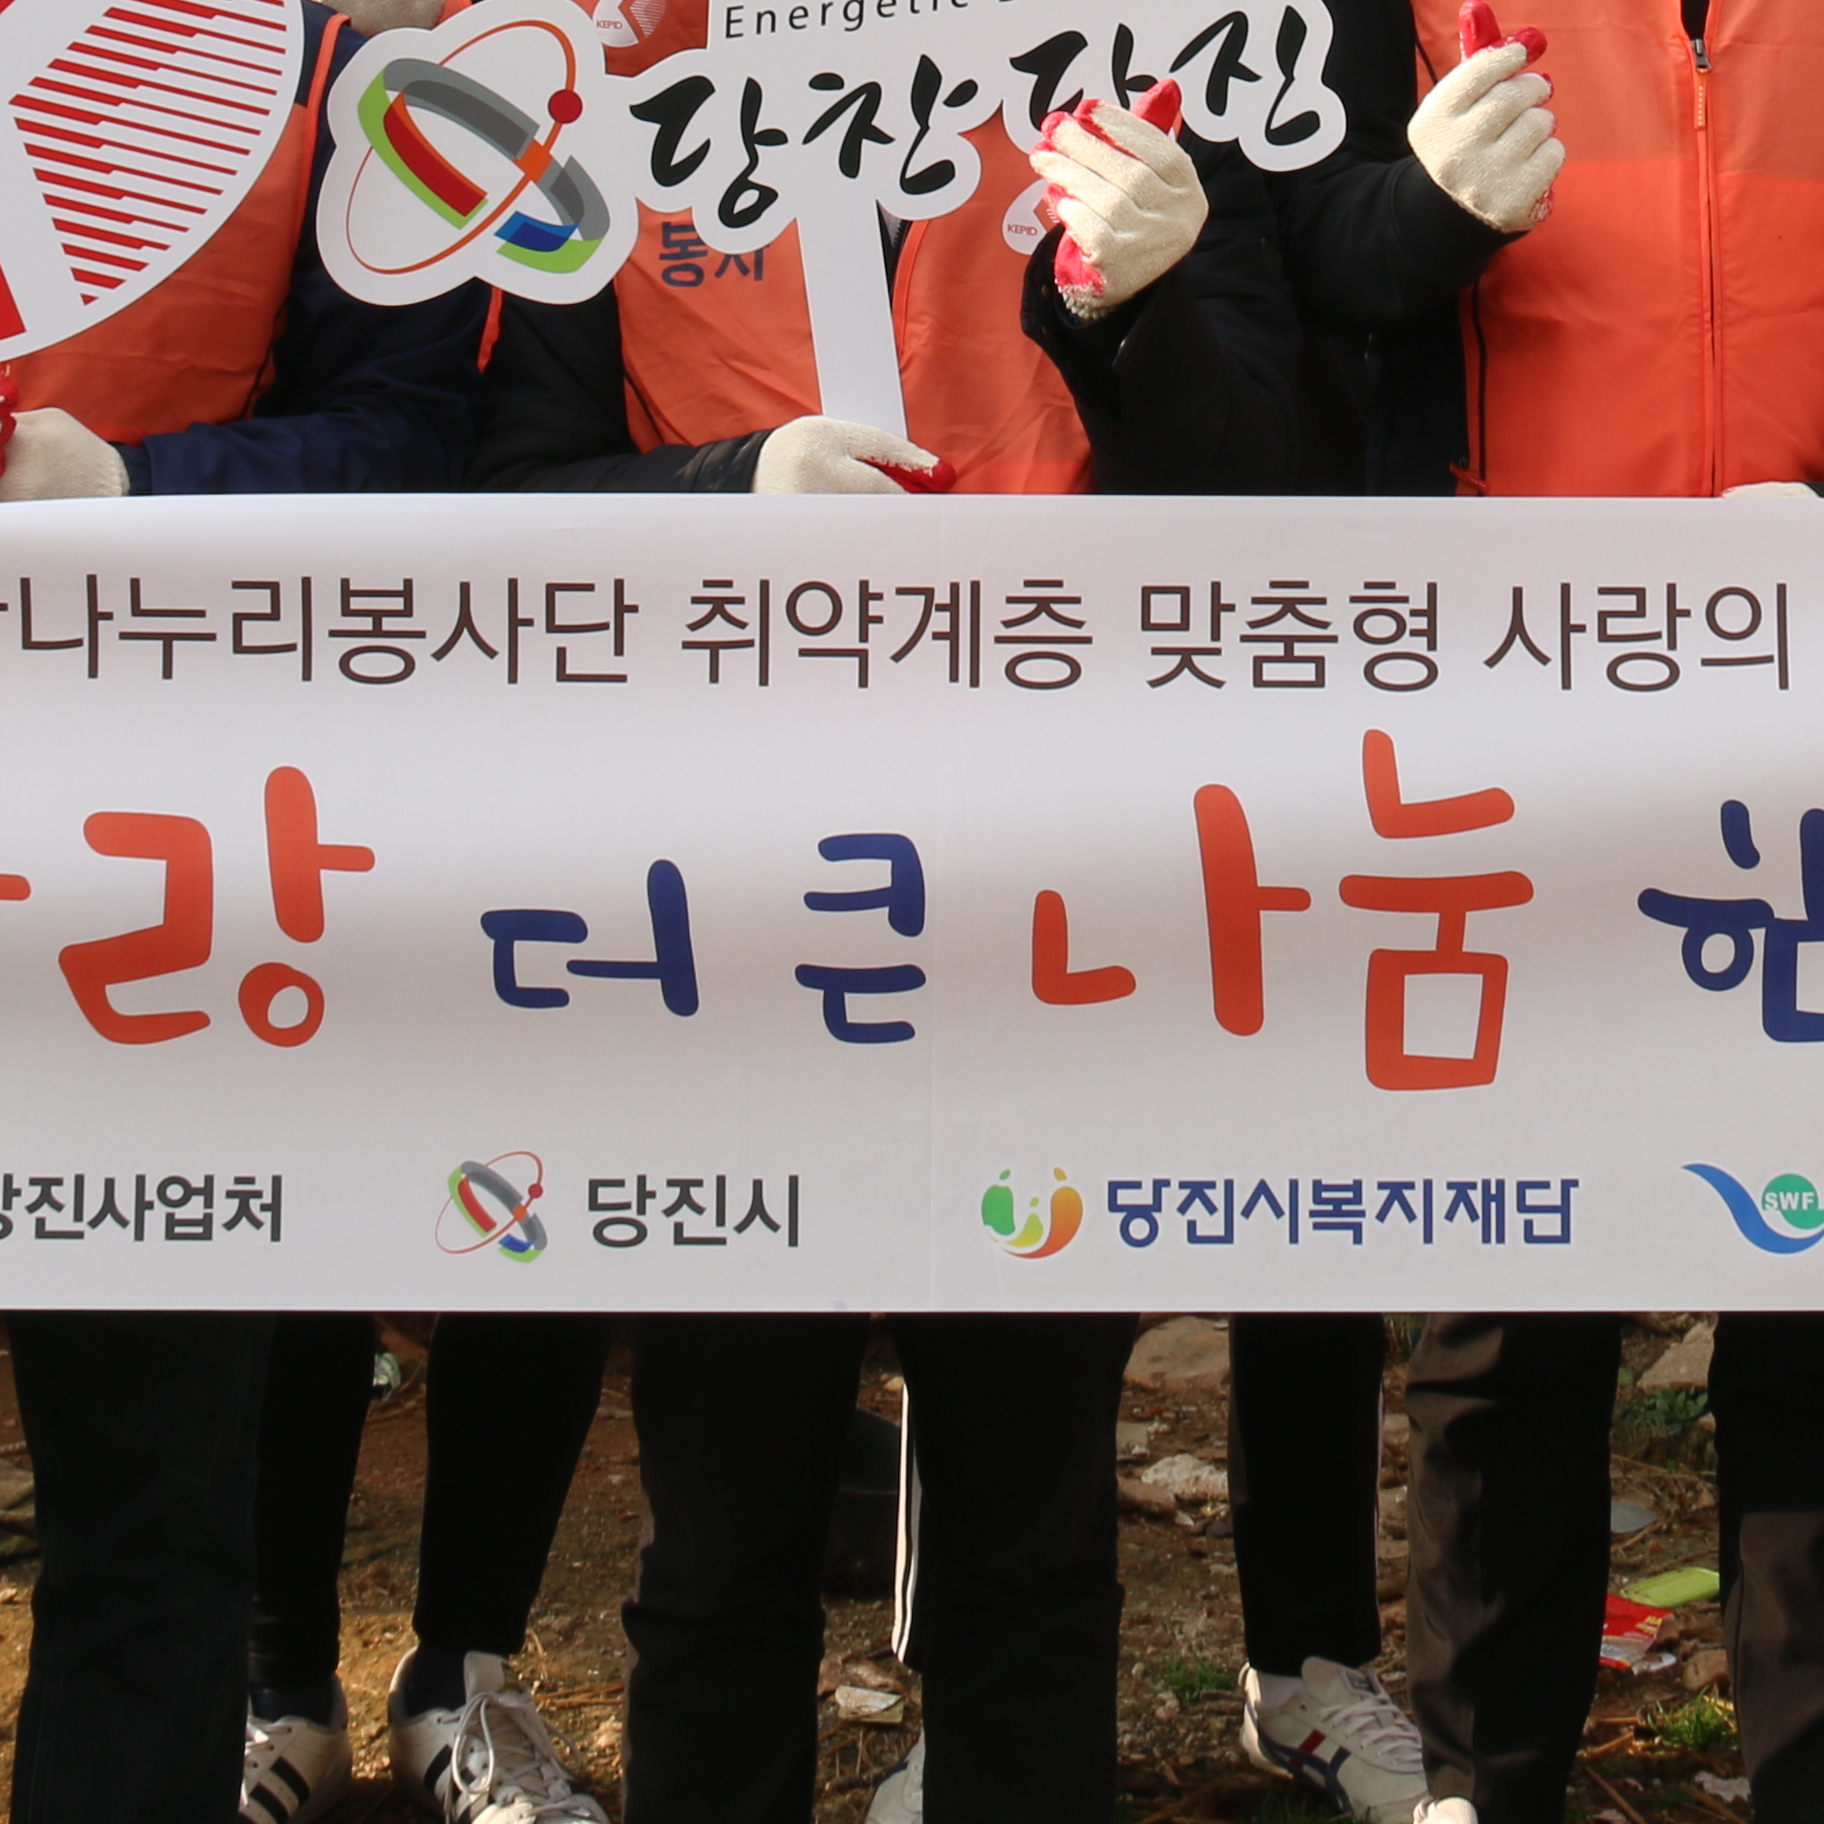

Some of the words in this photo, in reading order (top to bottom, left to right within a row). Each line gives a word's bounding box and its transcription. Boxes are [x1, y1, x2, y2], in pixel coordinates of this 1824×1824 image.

[1007, 223, 1038, 236] KEPID
[682, 579, 1093, 690] 취약계층
[1141, 580, 1438, 692] 맞춤형
[1483, 582, 1789, 692] 사랑의
[480, 859, 699, 1017] 더
[794, 833, 926, 1044] 큰
[1032, 728, 1534, 1091] 나눔
[587, 1173, 800, 1248] 당진시
[1106, 1175, 1580, 1249] 당진시복지재단
[1764, 1191, 1815, 1211] SWF
